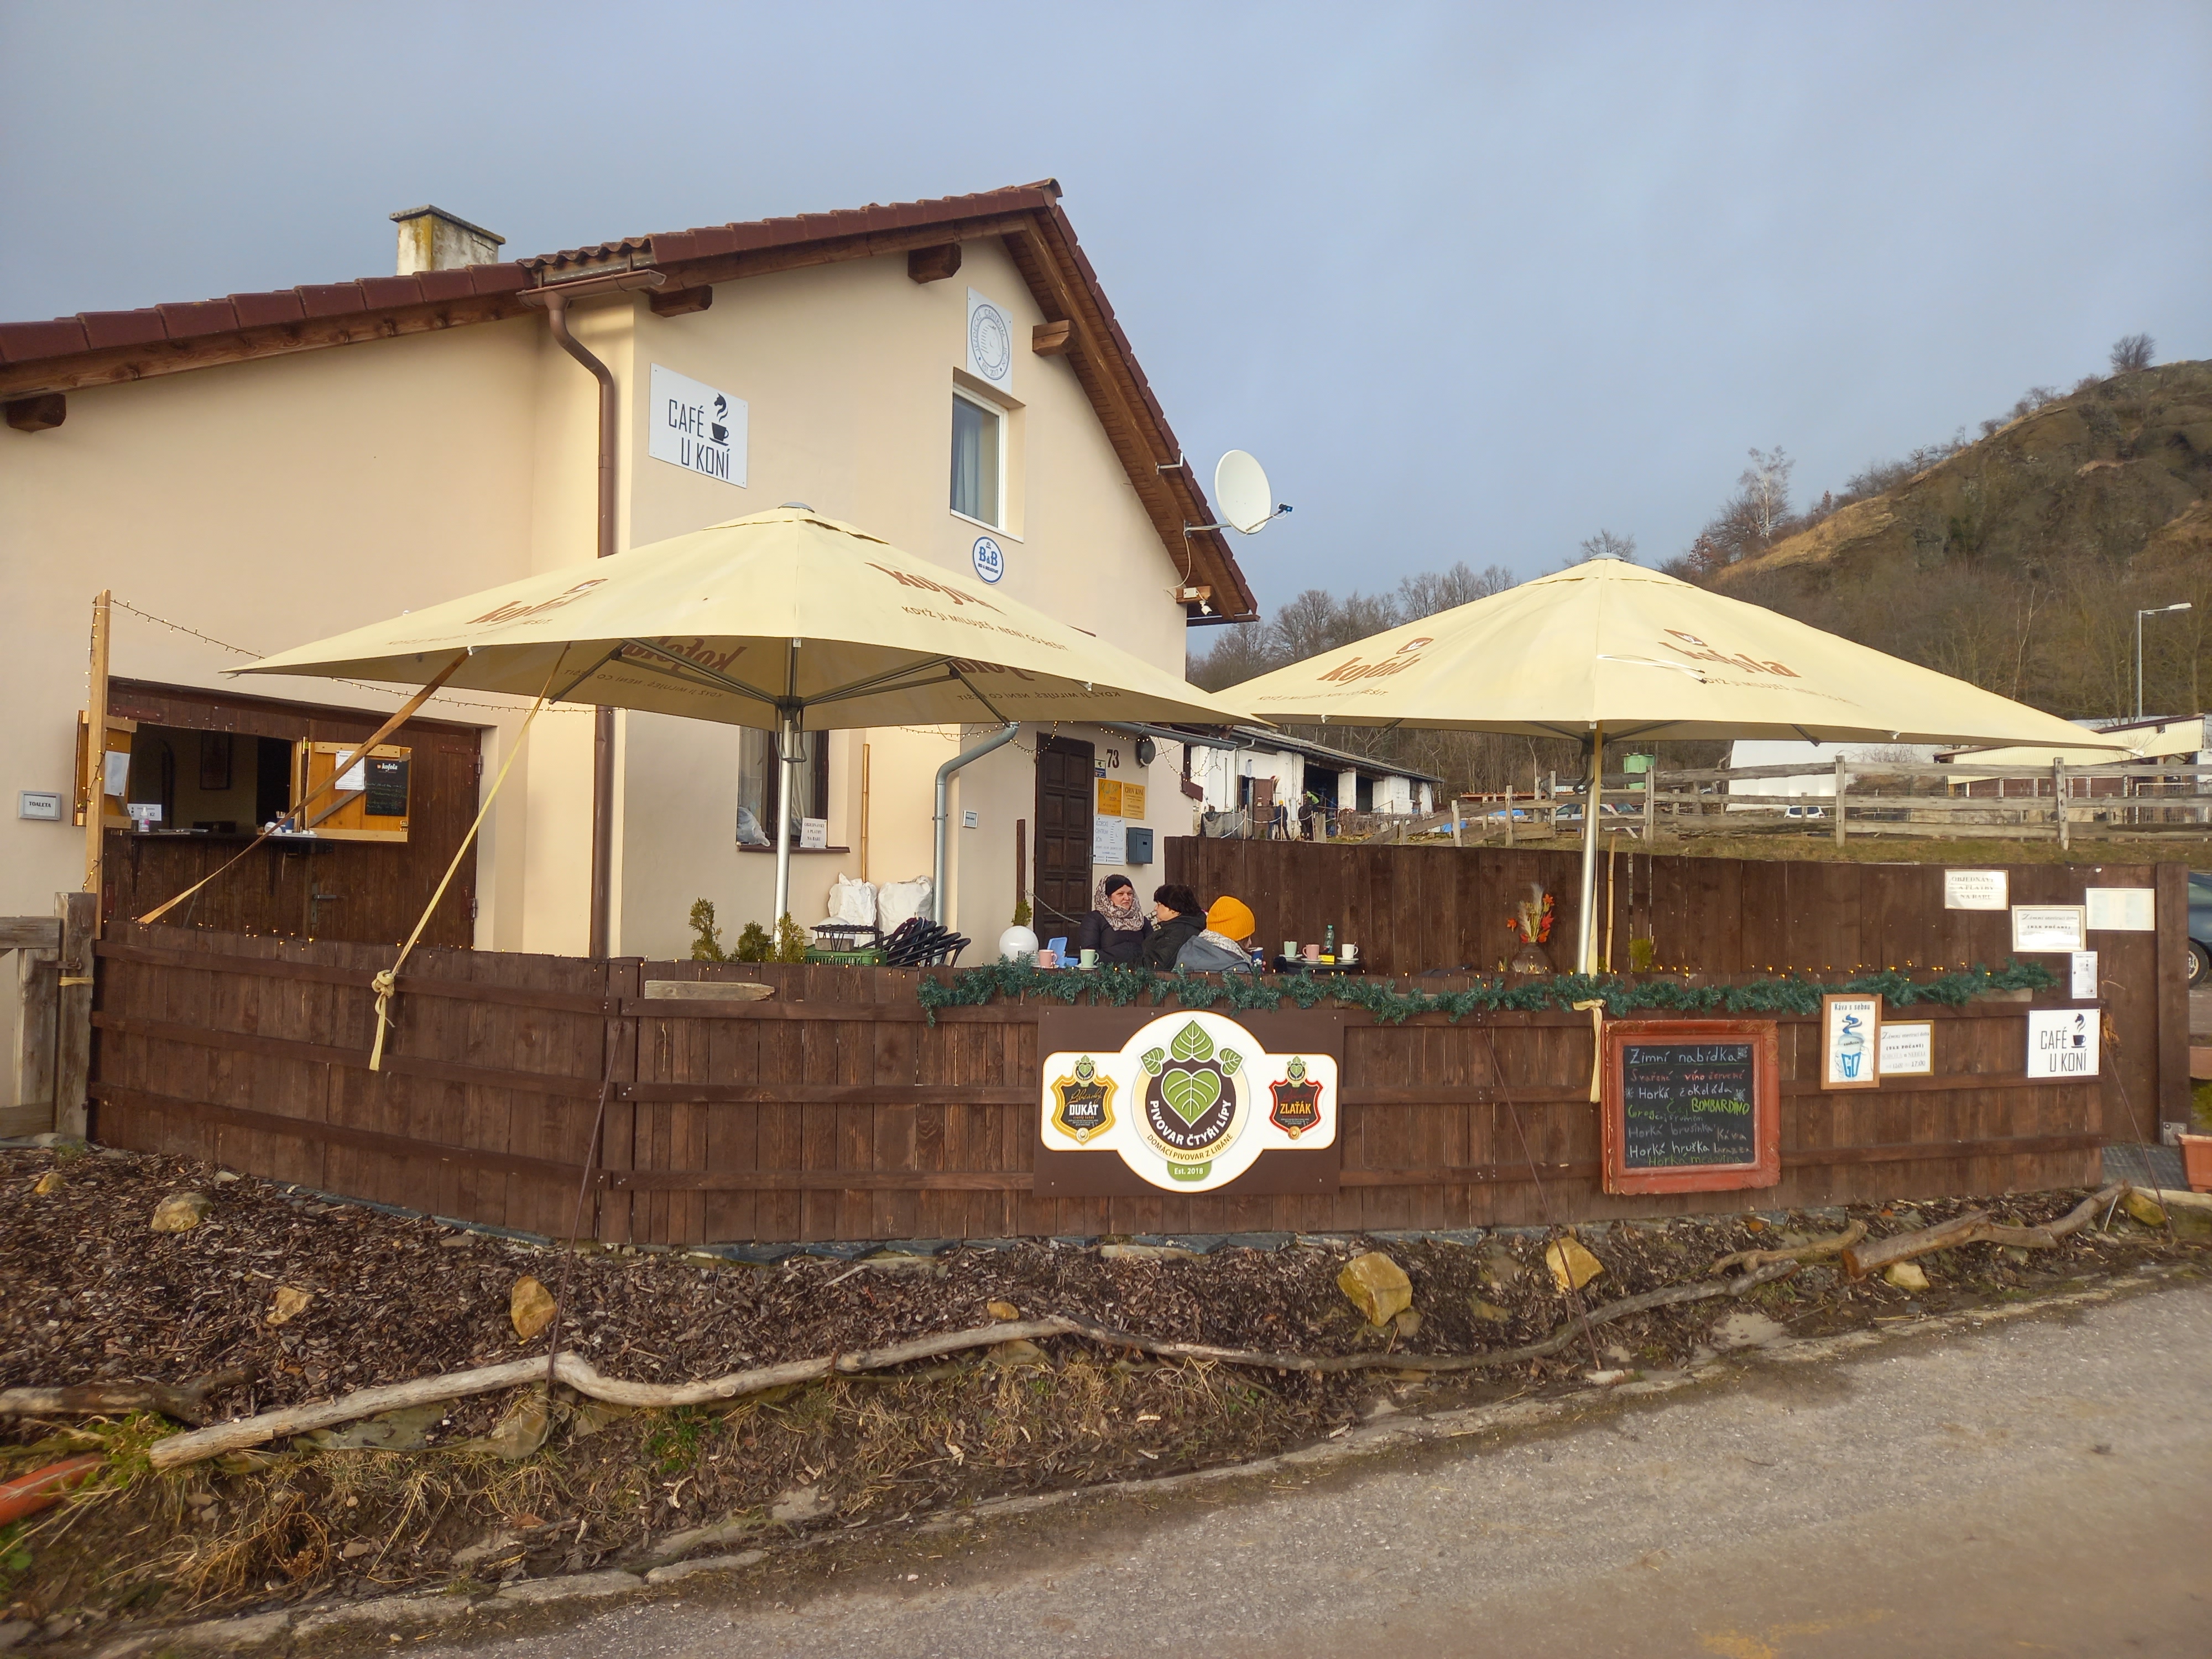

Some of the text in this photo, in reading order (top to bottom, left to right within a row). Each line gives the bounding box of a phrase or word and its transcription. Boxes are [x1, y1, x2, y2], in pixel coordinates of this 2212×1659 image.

[984, 309, 1005, 337] CENTRUM
[669, 399, 705, 439] CAFÉ
[681, 437, 730, 480] U KONÍ
[979, 546, 998, 566] B&B
[901, 606, 936, 619] KDYŽ
[940, 612, 948, 620] JI
[997, 626, 1025, 639] NENÍ
[1025, 634, 1041, 644] CO
[1316, 653, 1422, 687] kofola
[382, 763, 398, 771] kofola
[1107, 749, 1119, 769] 73
[1834, 1003, 1847, 1011] Káva
[2041, 1026, 2067, 1050] CAFÉ
[1630, 1048, 1670, 1064] Zimní
[1841, 1052, 1861, 1078] GO
[2050, 1048, 2087, 1072] U KONÍ
[1630, 1068, 1673, 1082] Svařené
[1684, 1070, 1705, 1081] víno
[1639, 1082, 1732, 1099] Horká čokoláda
[1069, 1102, 1099, 1116] DUKÁT
[1280, 1100, 1312, 1115] ZLAŤÁK
[1628, 1105, 1655, 1120] Grog
[1691, 1097, 1750, 1116] BOMBARDINO
[1150, 1099, 1232, 1146] PIVOVAR ČTYŘI LÍPY
[1629, 1124, 1663, 1139] Horká
[1717, 1127, 1747, 1142] Káva
[1147, 1134, 1172, 1157] DOMÁCÍ
[1173, 1151, 1204, 1161] PIVOVAR
[1630, 1140, 1710, 1159] Horká hruška
